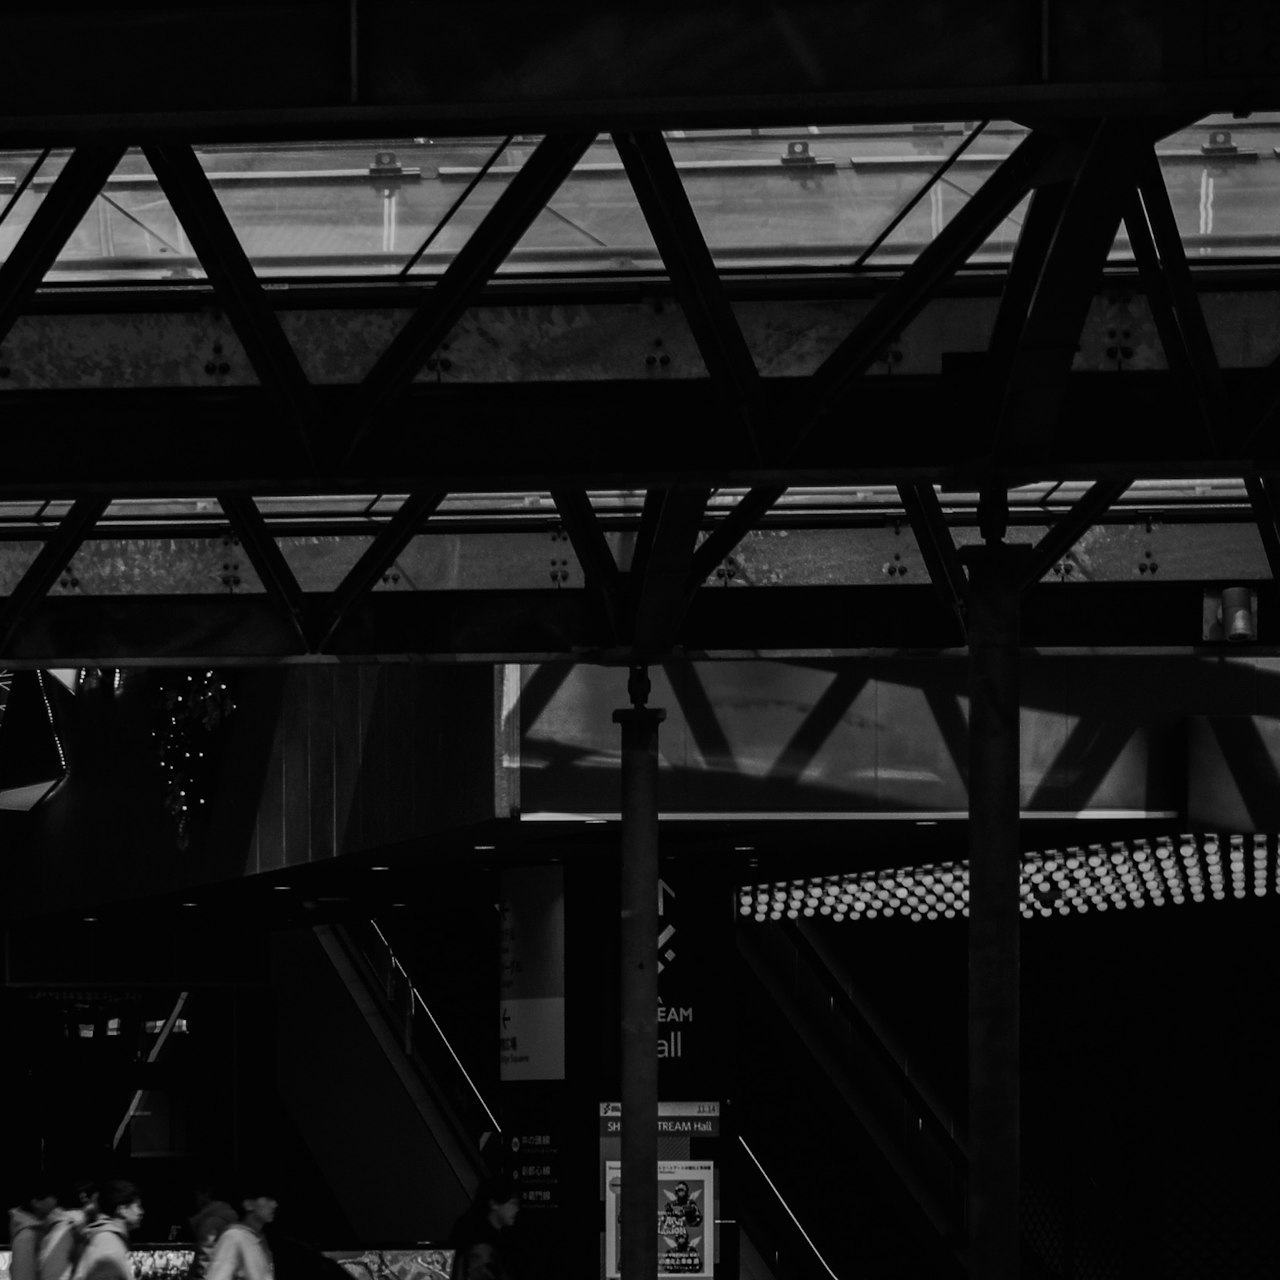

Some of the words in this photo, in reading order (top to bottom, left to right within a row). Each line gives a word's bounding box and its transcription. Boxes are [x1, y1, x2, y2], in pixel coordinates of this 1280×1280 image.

[657, 1007, 694, 1022] EAM
[657, 1031, 682, 1058] all
[657, 1121, 692, 1131] TREAM
[693, 1121, 713, 1131] Hall
